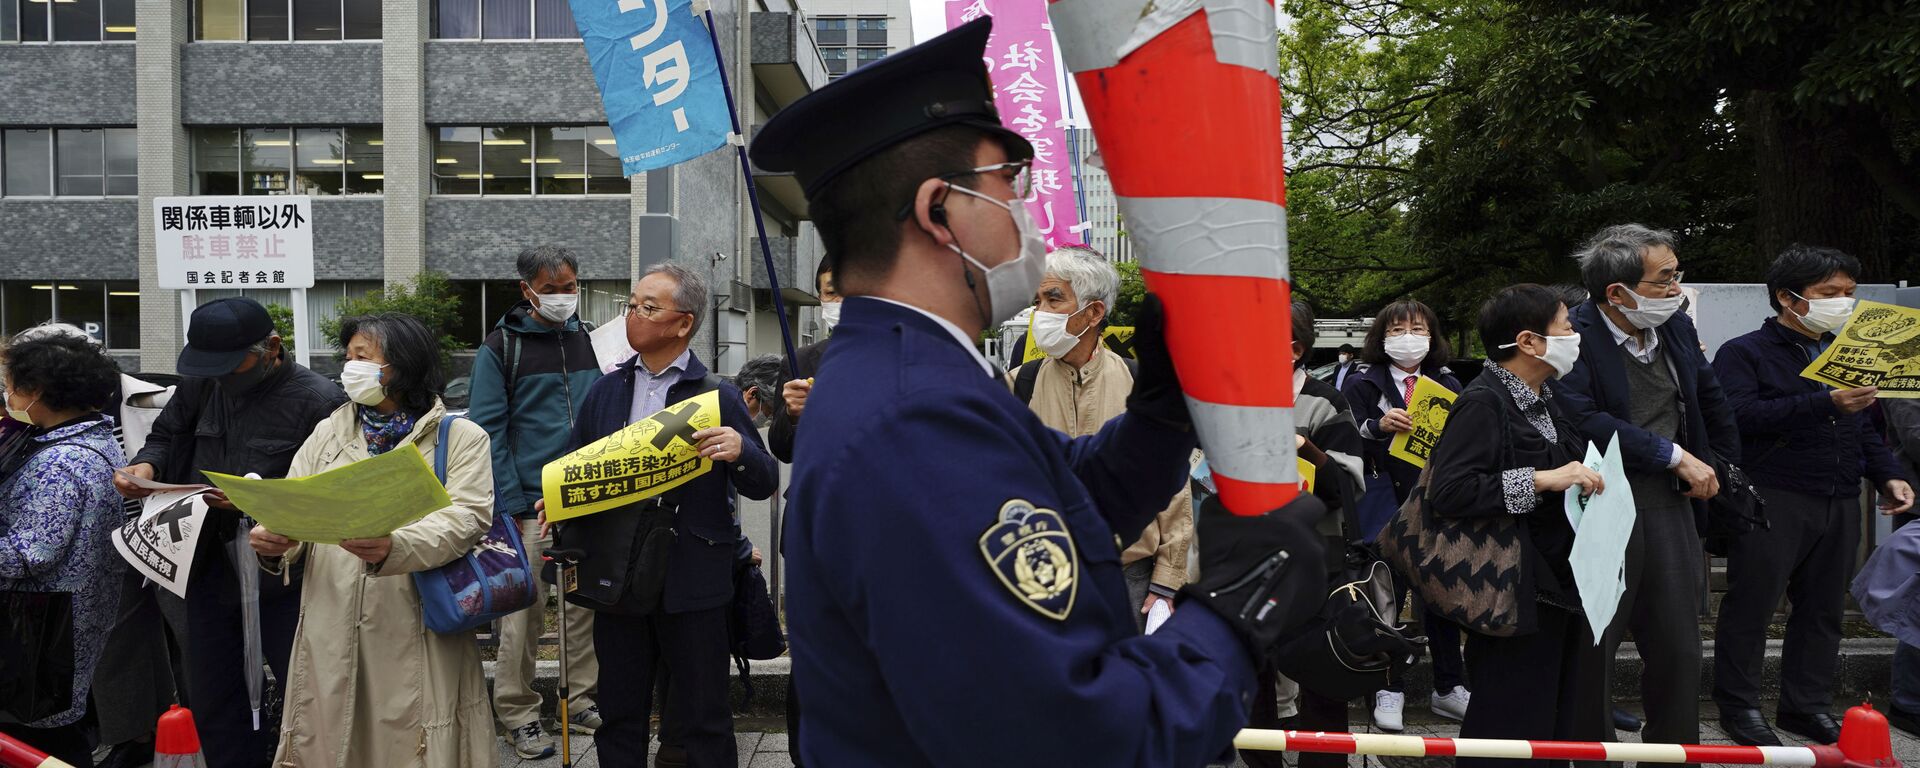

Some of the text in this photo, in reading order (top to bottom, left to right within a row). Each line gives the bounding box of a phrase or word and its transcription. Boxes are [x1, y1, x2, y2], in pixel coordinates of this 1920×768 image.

[162, 204, 305, 231] 関係車輌以外
[181, 234, 286, 260] 駐車禁止
[187, 270, 285, 284] 国会記者会館
[1834, 355, 1874, 365] 決めるな
[1839, 347, 1869, 356] 勝手に
[1823, 364, 1881, 386] 流すな!
[563, 452, 677, 483] 放射能汚染水
[567, 459, 697, 504] 流すな! 国民無視
[128, 532, 172, 577] 国民無視
